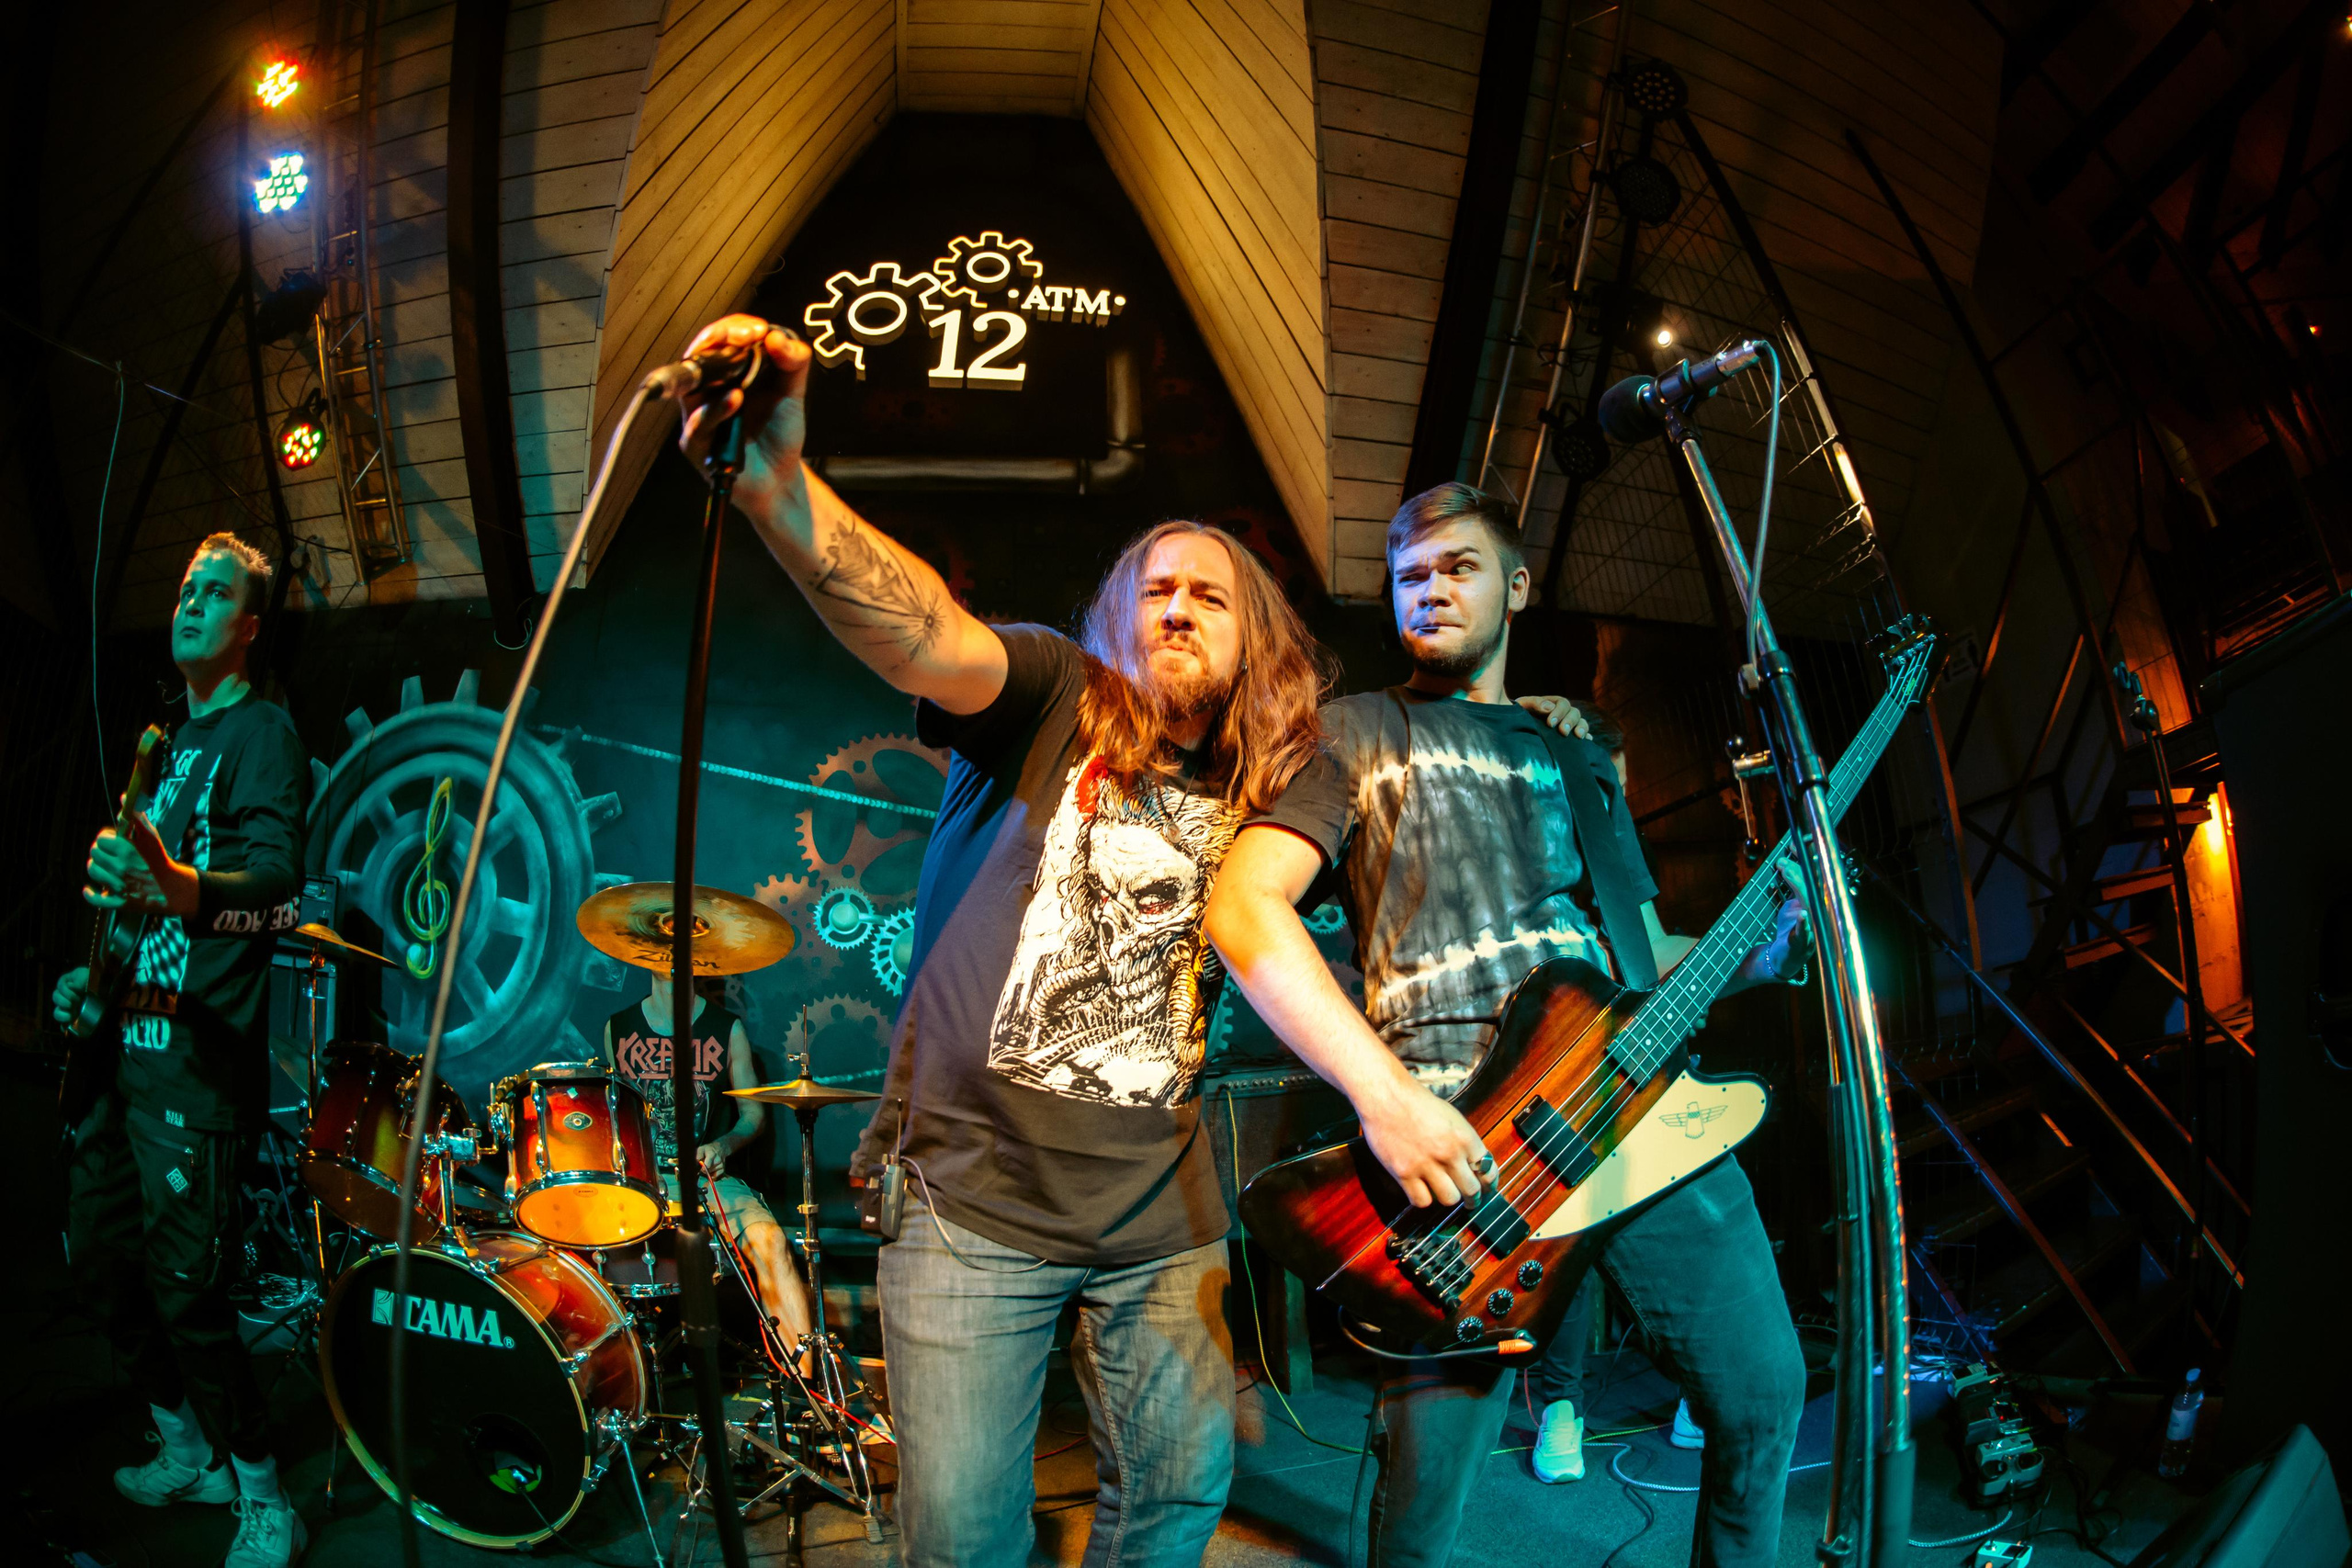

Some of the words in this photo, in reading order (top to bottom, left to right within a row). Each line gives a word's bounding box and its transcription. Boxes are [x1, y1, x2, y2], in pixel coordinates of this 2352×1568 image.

[928, 309, 1027, 381] 12
[633, 949, 720, 969] Zilan
[616, 1031, 724, 1081] KREAOR
[401, 1293, 504, 1348] TAMA
